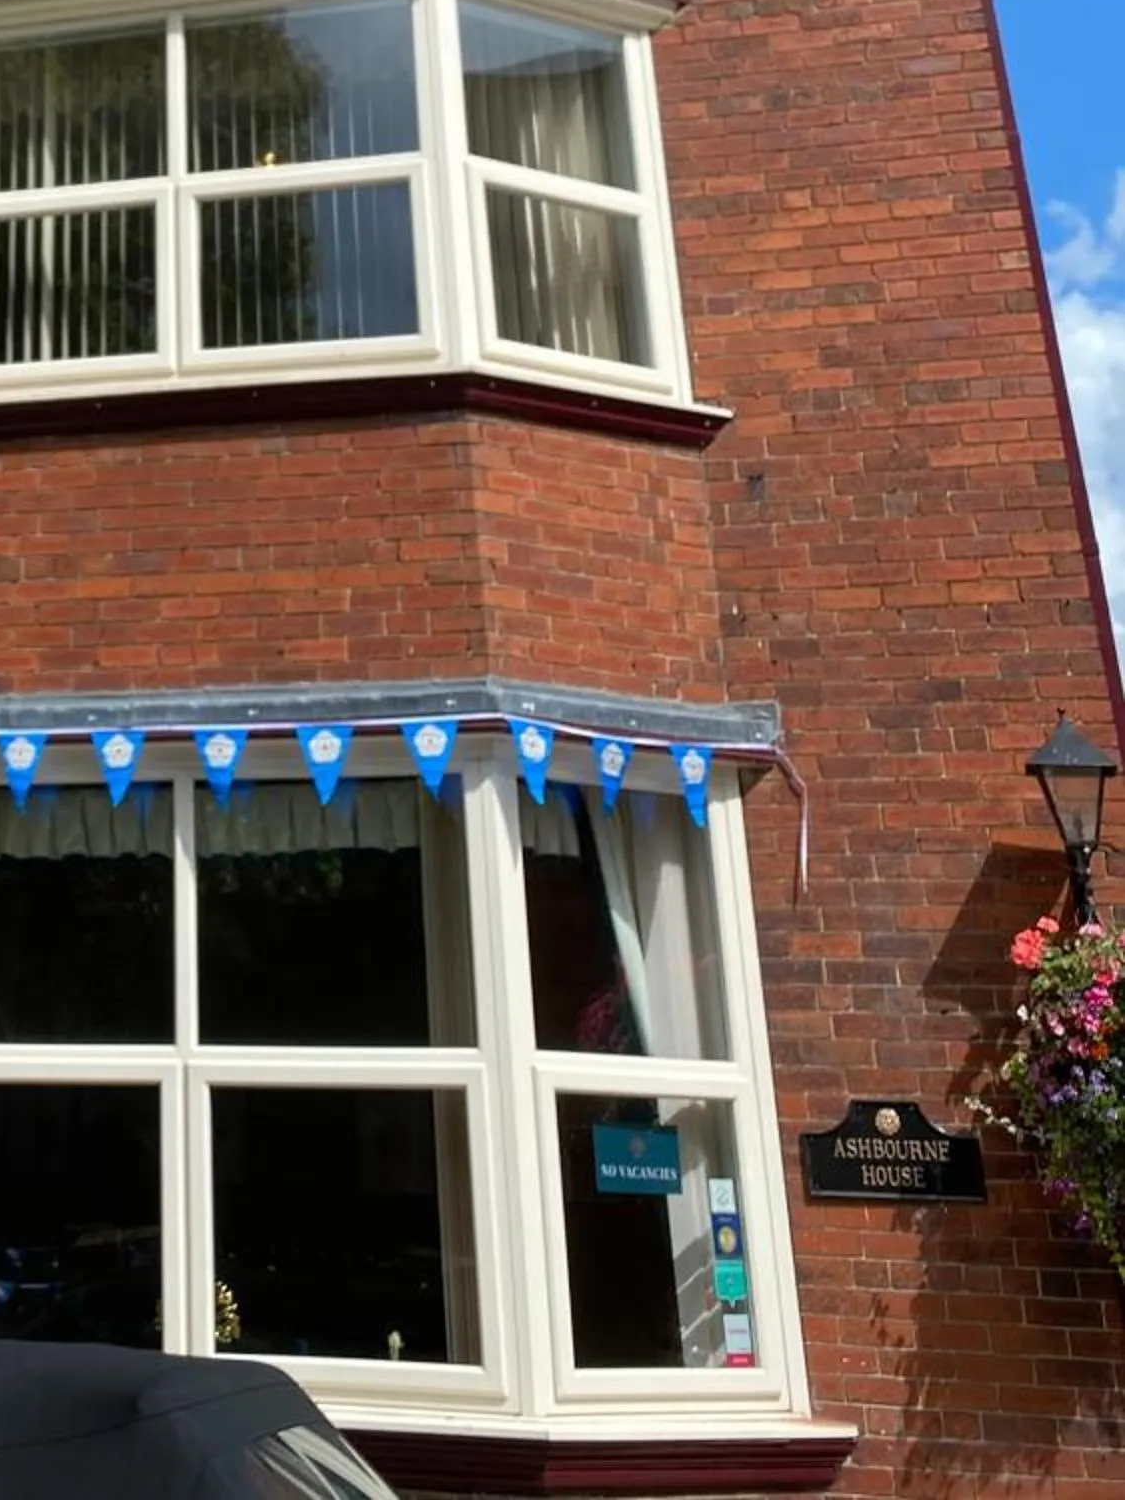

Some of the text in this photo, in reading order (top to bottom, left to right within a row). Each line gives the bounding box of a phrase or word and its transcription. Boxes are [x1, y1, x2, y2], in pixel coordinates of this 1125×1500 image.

[833, 1136, 952, 1163] ASHBOURNE
[600, 1163, 618, 1178] NO
[860, 1164, 926, 1189] HOUSE
